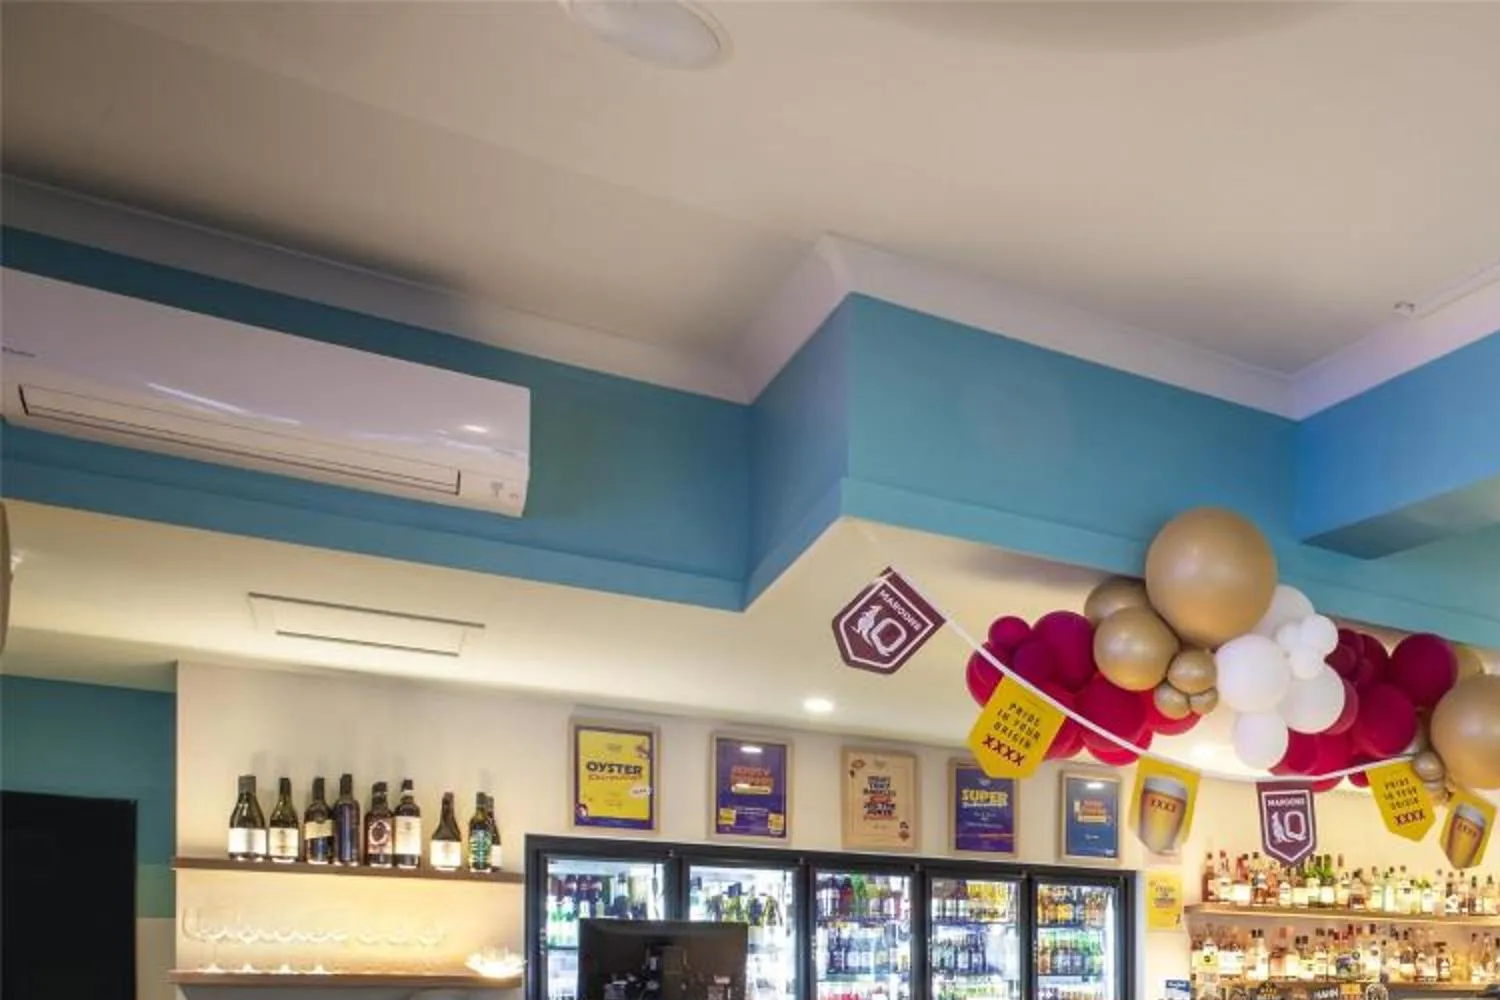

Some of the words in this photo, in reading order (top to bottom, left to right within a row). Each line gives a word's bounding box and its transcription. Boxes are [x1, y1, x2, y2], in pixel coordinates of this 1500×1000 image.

[996, 708, 1011, 722] IN
[1013, 717, 1041, 741] YOUR
[1008, 702, 1041, 728] PRIDE
[993, 721, 1032, 749] ORIGIN
[981, 733, 1026, 767] XXXX
[586, 761, 643, 775] OYSTER
[960, 788, 1009, 804] SUPER
[1150, 797, 1178, 814] XXXX
[1393, 808, 1426, 827] XXXX
